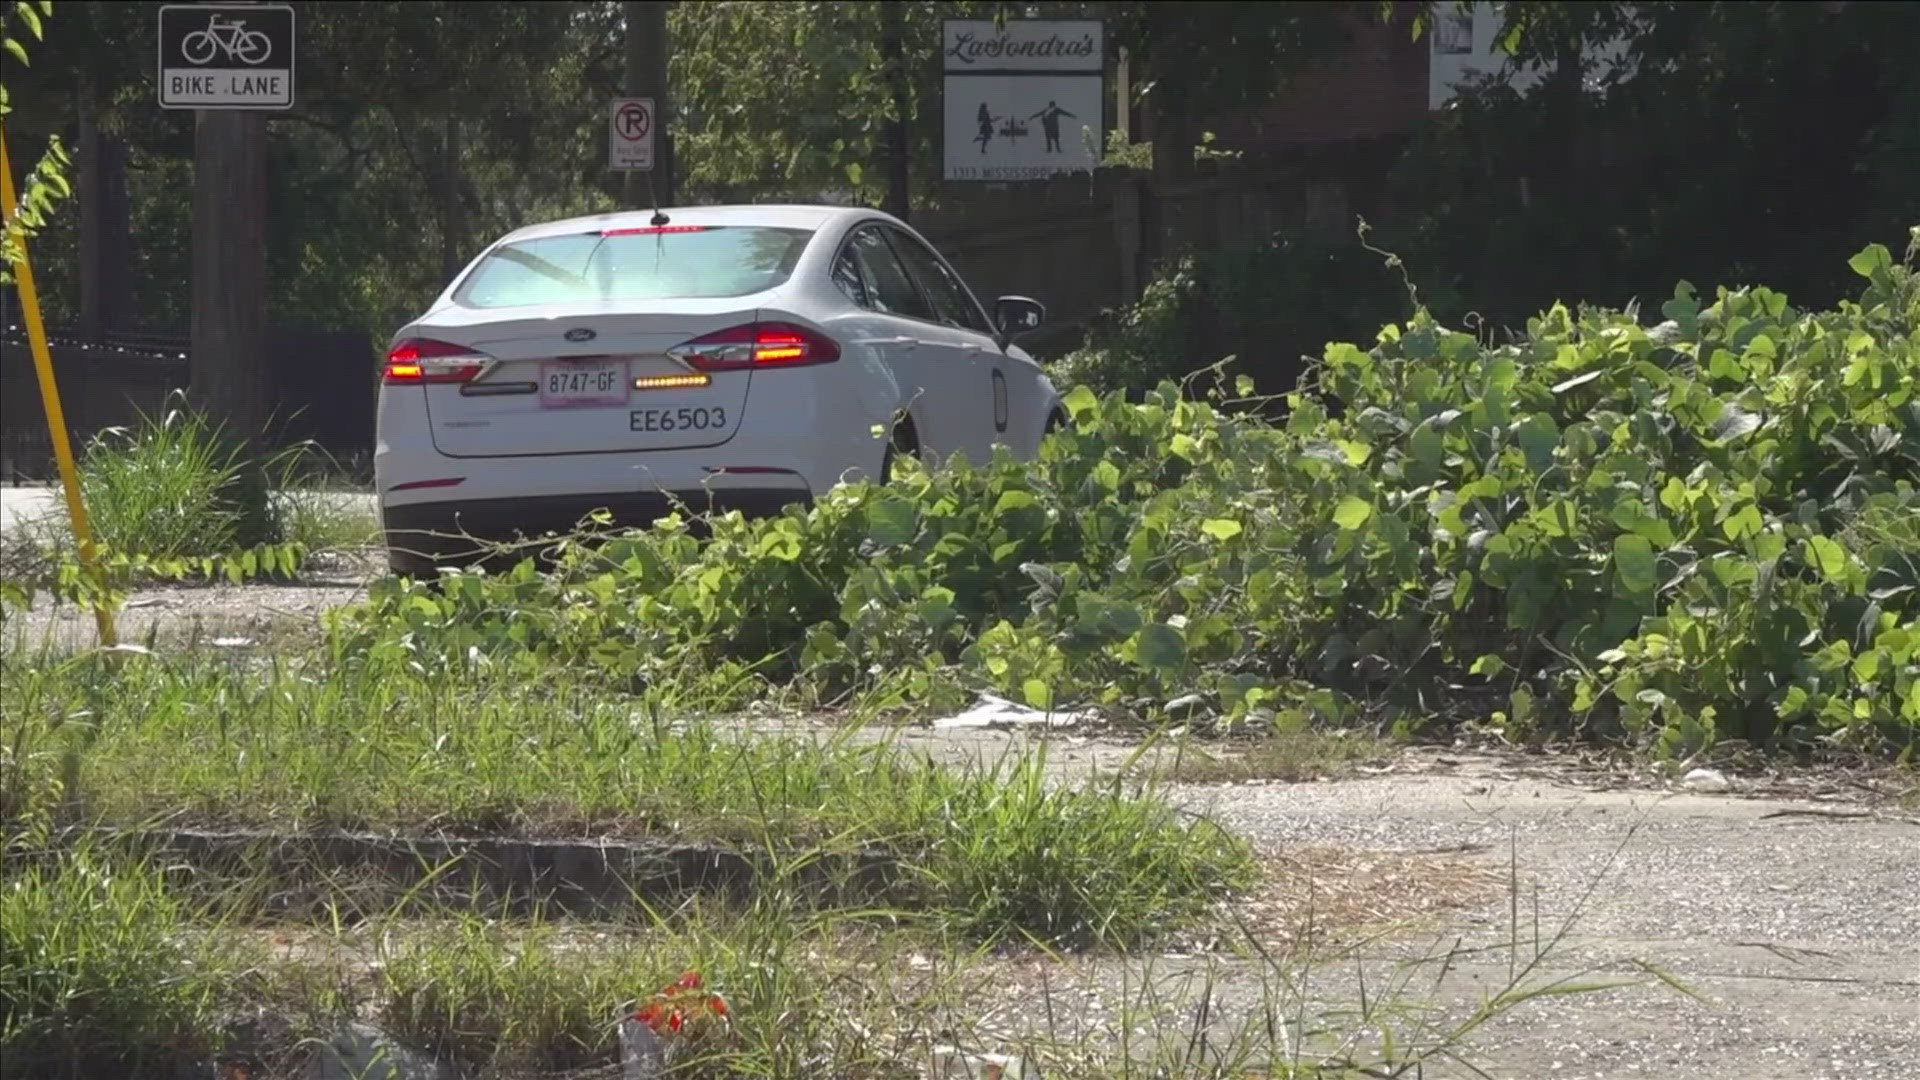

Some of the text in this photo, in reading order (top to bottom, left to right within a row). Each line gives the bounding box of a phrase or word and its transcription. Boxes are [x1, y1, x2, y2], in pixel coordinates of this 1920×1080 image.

[948, 32, 1093, 64] LaSondra's
[172, 76, 281, 95] BIKE LANE
[550, 371, 616, 393] 8747-GF
[629, 407, 727, 432] EE6503
